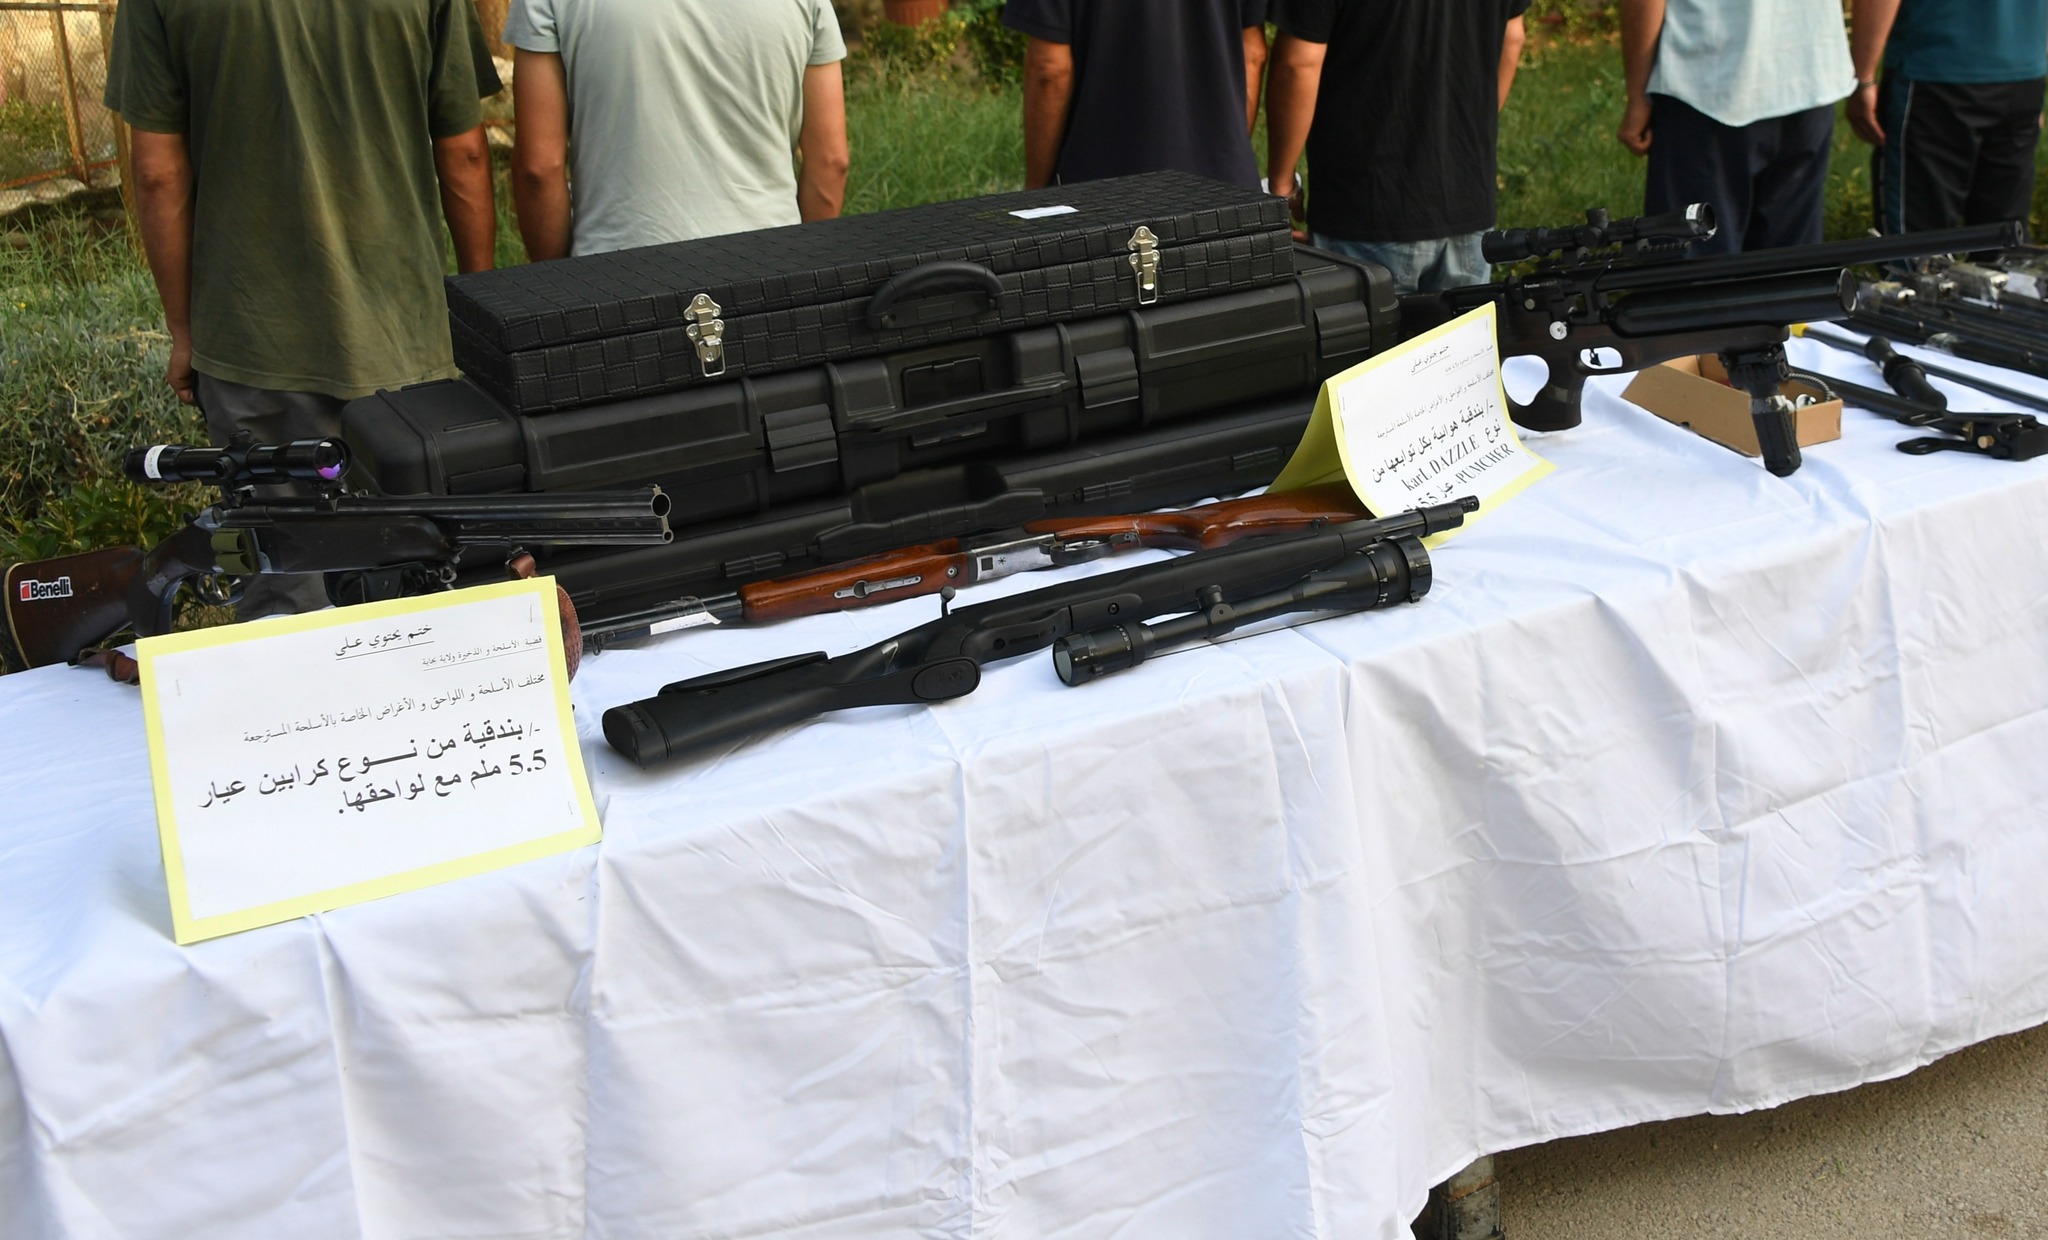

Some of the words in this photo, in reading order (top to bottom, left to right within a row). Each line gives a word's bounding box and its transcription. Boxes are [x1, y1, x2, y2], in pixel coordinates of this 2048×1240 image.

[1461, 403, 1484, 426] بندقية
[1484, 418, 1501, 444] نوع
[1418, 435, 1432, 455] بكل
[1429, 434, 1480, 474] DAZZLE
[1372, 467, 1386, 483] من
[31, 578, 70, 598] Benelli
[369, 629, 402, 649] يحتوي
[492, 640, 520, 652] الأسلحة
[478, 678, 514, 695] الأسلحة
[518, 673, 545, 688] مختلف
[420, 702, 426, 711] و
[430, 688, 465, 710] اللواحق
[470, 692, 475, 701] و
[340, 706, 373, 723] الخاصة
[376, 697, 416, 721] الأغراض
[243, 723, 292, 744] المسترجعة
[295, 714, 336, 733] بالأسلحة
[463, 718, 523, 750] بندقية
[426, 737, 457, 759] من
[508, 748, 547, 776] 5.5
[259, 758, 329, 795] كرابين
[434, 771, 462, 797] مع
[470, 759, 502, 790] ملم
[198, 780, 246, 808] عيار
[338, 773, 425, 814] لواحقها.
